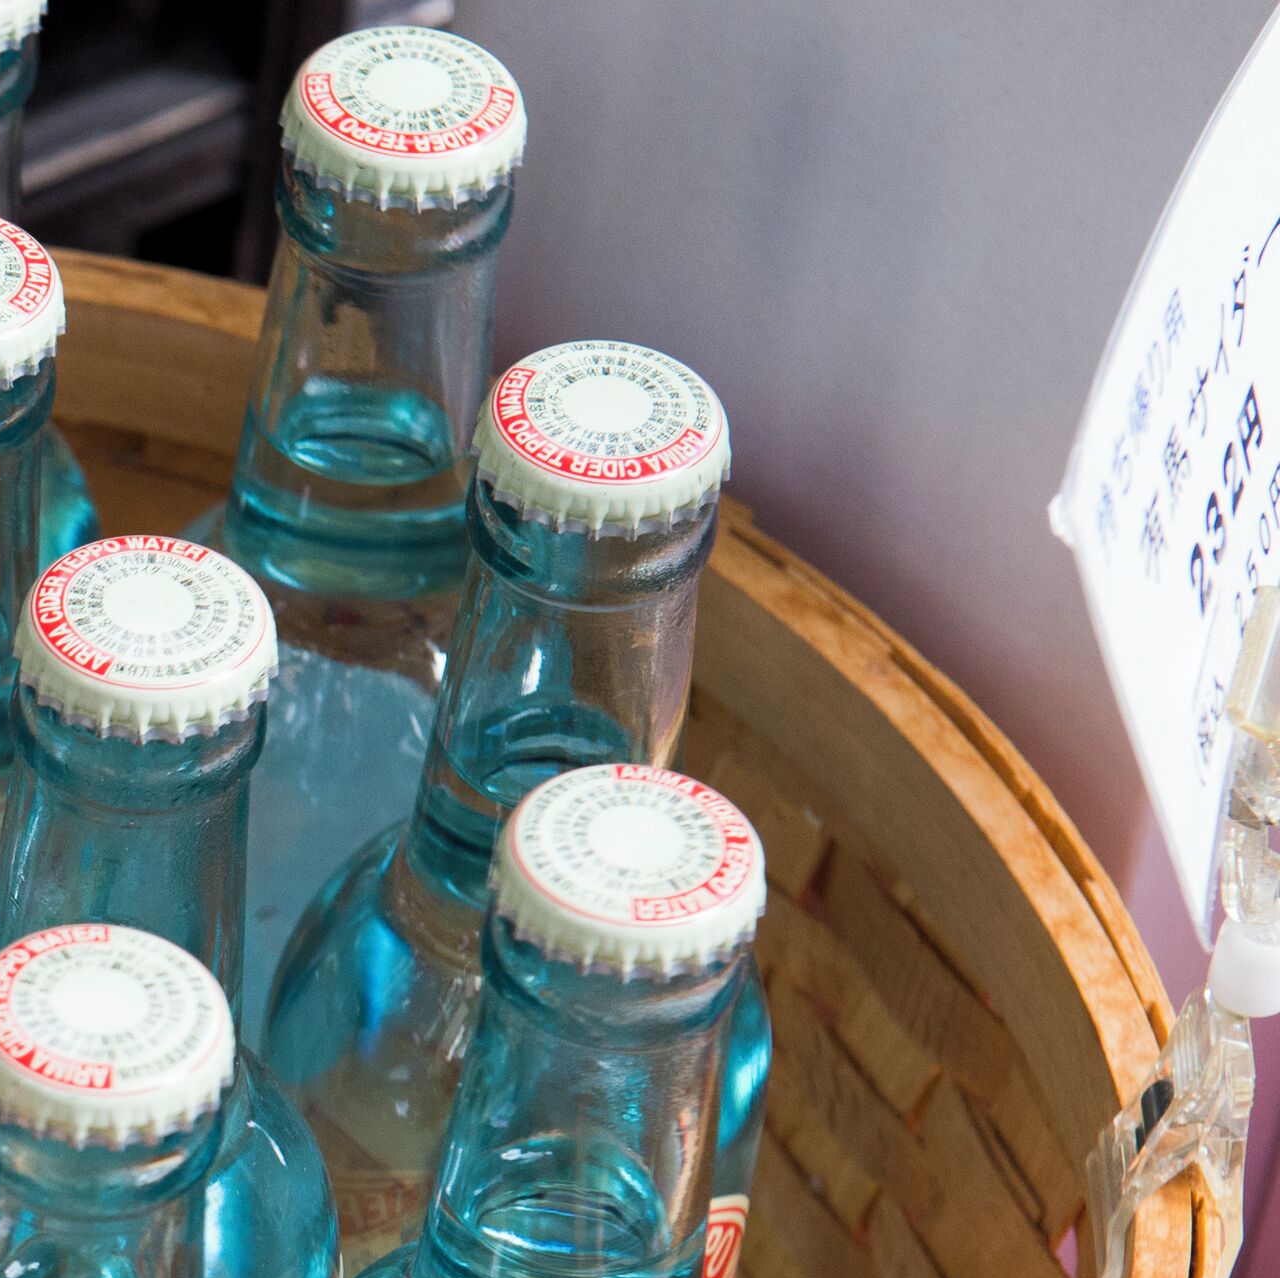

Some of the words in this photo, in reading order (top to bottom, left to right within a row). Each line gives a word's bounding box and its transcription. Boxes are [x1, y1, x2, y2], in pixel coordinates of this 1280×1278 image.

[306, 75, 341, 122] WATER
[473, 87, 515, 133] ARIMA
[338, 117, 409, 151] TEPPO
[414, 128, 478, 152] CIDER
[14, 262, 50, 312] WATER
[497, 370, 534, 419] WATER
[507, 423, 565, 470] TEPPO
[569, 455, 641, 478] CIDER
[646, 431, 705, 474] ARIMA
[1190, 381, 1263, 618] 232円
[60, 541, 121, 574] TEPPO
[126, 537, 208, 562] WATER
[39, 573, 65, 624] CIDER
[48, 629, 112, 673] ARIMA
[619, 766, 696, 794] ARIMA
[26, 927, 108, 952] WATER
[31, 1051, 110, 1088] ARIMA
